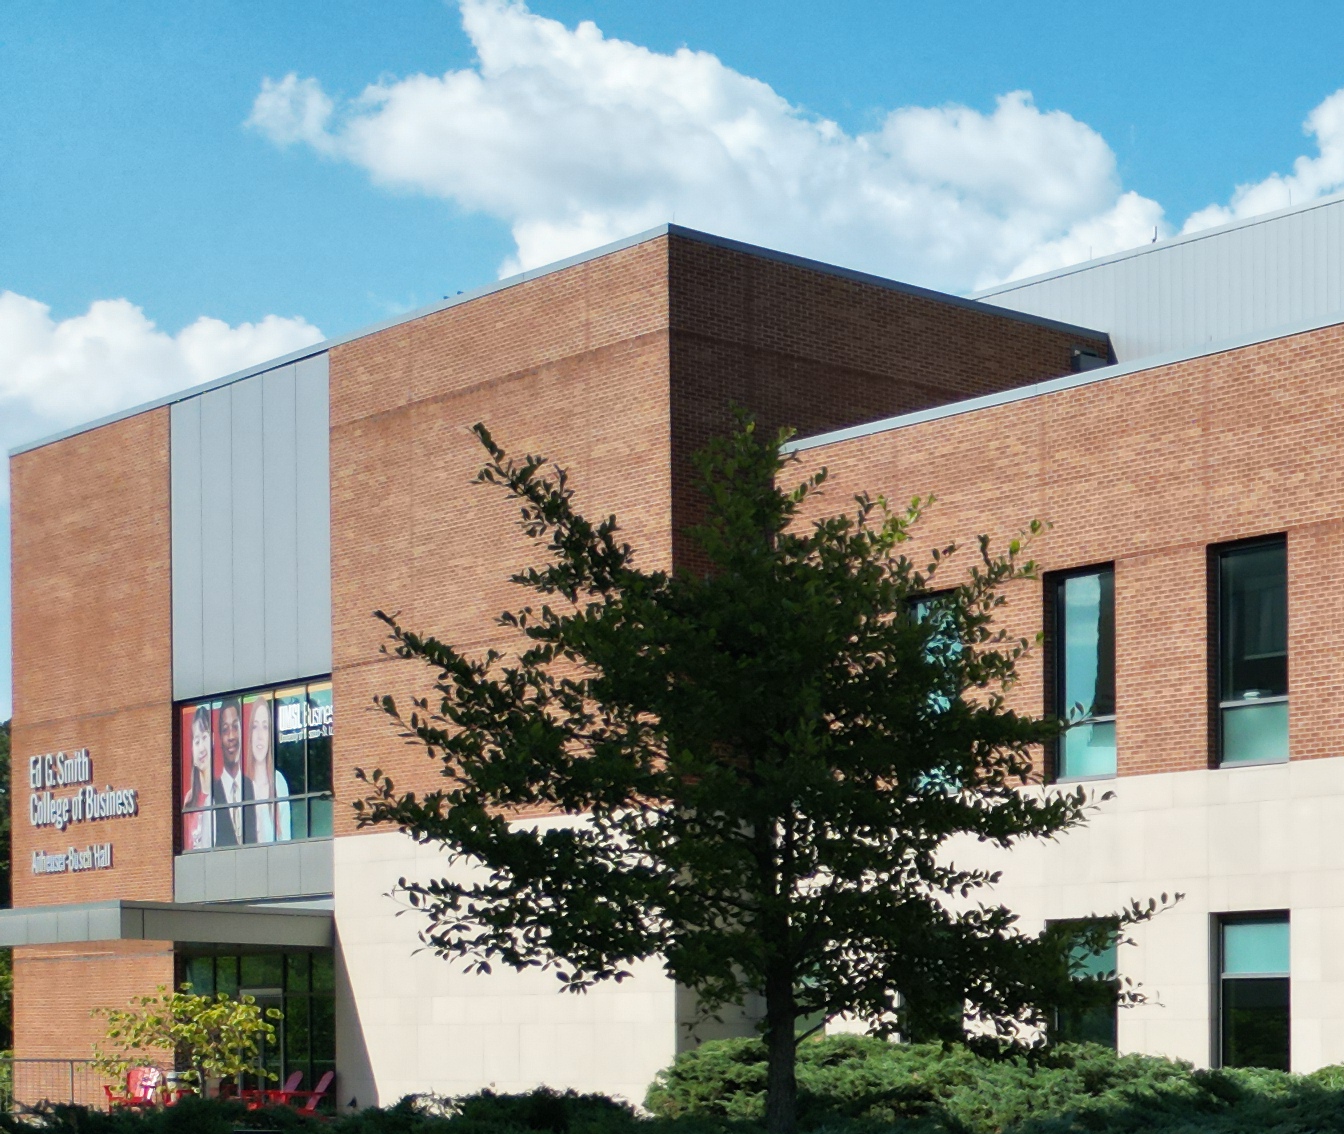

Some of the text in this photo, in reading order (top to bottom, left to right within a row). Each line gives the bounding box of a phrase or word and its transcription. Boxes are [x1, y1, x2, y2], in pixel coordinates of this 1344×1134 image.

[30, 748, 90, 789] Ed G. Smith
[30, 785, 136, 829] College of Business
[93, 843, 112, 870] Hall
